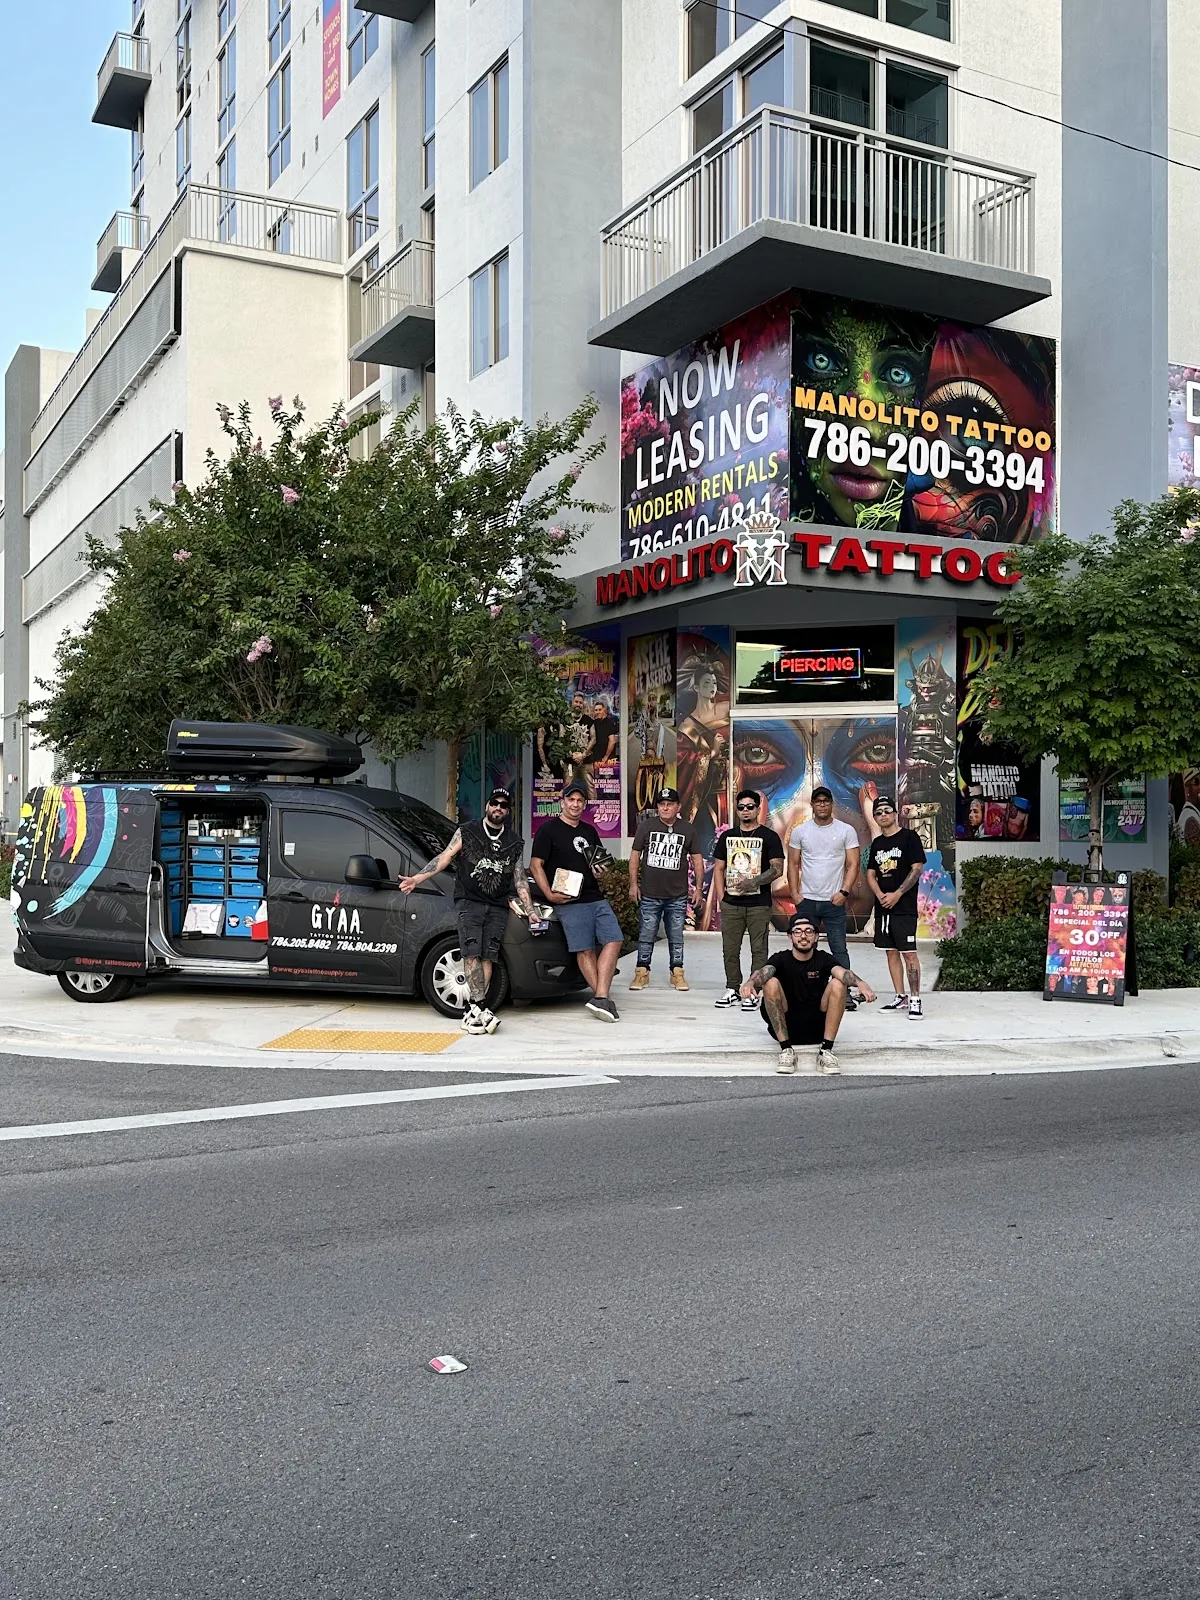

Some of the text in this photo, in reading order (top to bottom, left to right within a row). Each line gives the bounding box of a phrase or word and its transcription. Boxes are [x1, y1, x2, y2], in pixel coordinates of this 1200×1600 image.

[659, 339, 740, 422] NOW
[794, 386, 1052, 452] MANOLITO TATTOO
[636, 392, 769, 491] LEASING
[804, 418, 1045, 494] 786-200-3394
[628, 451, 779, 529] MODERN RENTALS
[596, 538, 734, 606] MANOLITO
[634, 633, 671, 677] ASERE
[780, 656, 854, 672] PIERCING
[635, 663, 672, 694] DE ASERES
[971, 764, 1020, 782] MANOLITO
[980, 781, 1017, 797] TATTOO
[1064, 803, 1086, 815] miami
[593, 813, 620, 823] 24/7
[1117, 815, 1145, 826] 24/7
[656, 833, 678, 844] I AM
[727, 839, 761, 849] WANTED
[649, 842, 681, 859] BLACK
[647, 856, 679, 869] HISTORY
[311, 904, 361, 934] GYAA
[1053, 908, 1069, 916] 786
[1054, 918, 1090, 926] ESPECIAL
[1109, 919, 1123, 927] DÍA
[271, 937, 398, 953] 786.205.8482 786.804.2398
[1069, 929, 1120, 946] 30 OFF
[1072, 949, 1098, 957] TODOS
